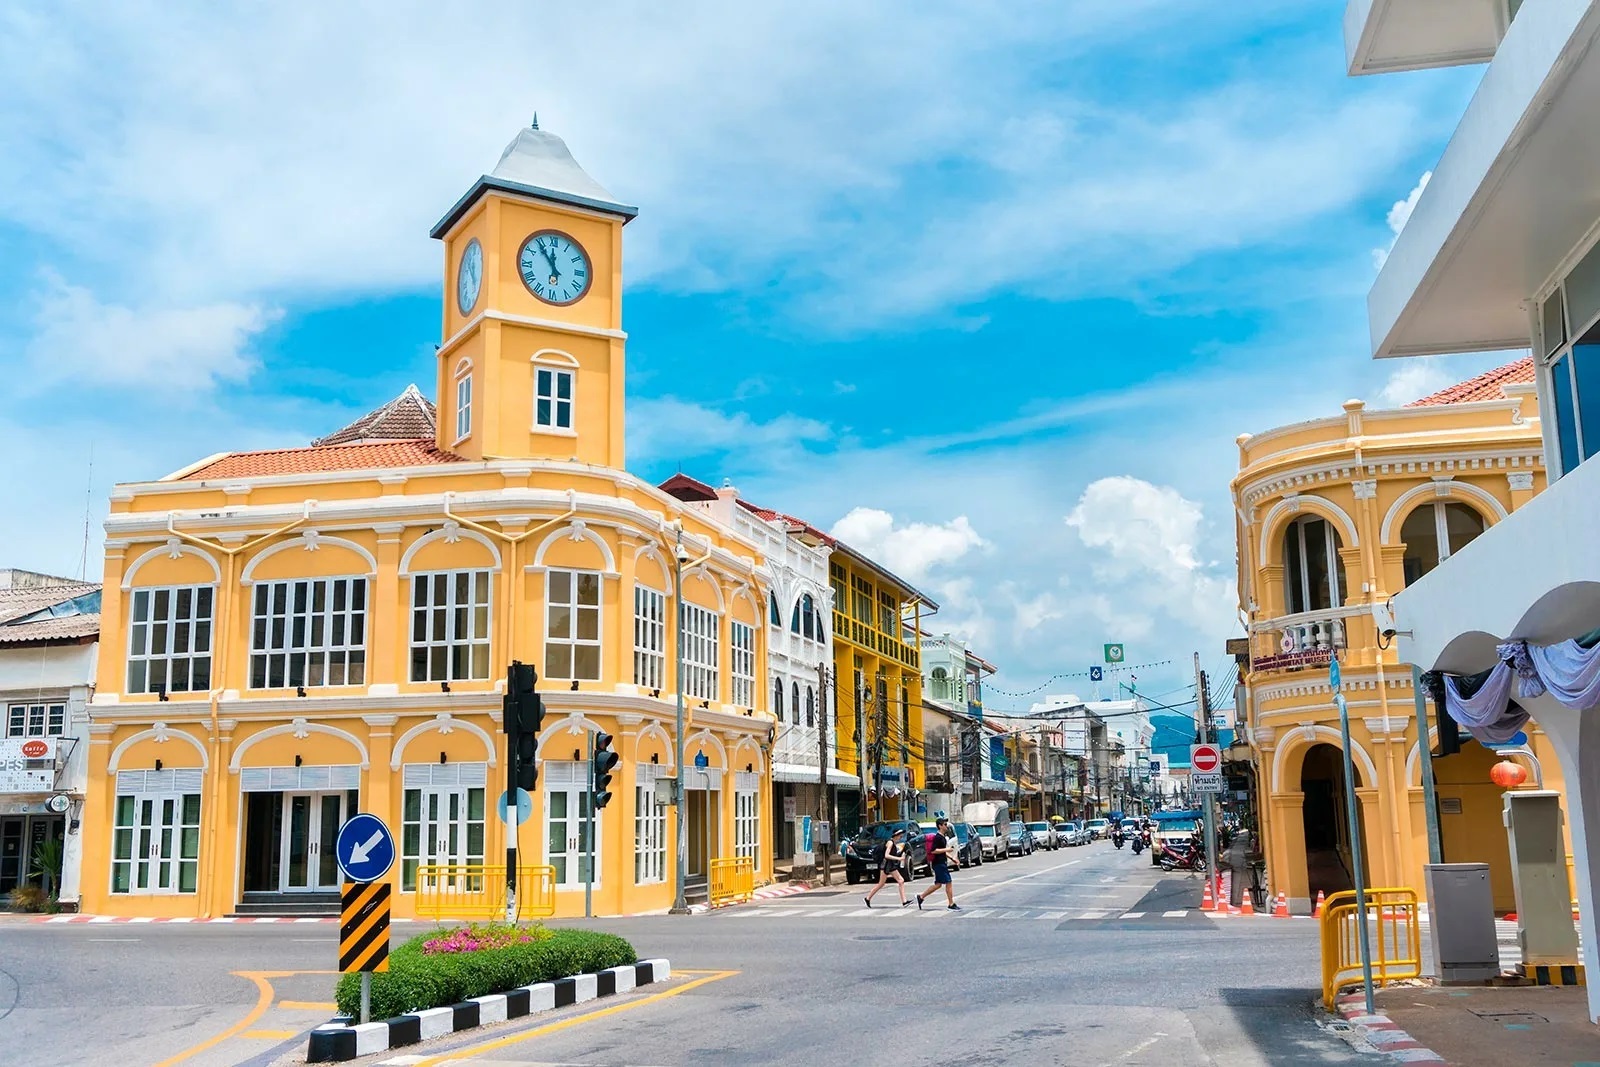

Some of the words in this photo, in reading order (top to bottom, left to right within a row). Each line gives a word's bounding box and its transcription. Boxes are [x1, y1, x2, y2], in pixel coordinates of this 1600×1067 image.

[525, 246, 537, 256] X
[564, 244, 570, 252] I
[522, 259, 533, 269] IX
[548, 289, 557, 301] VI
[563, 290, 571, 300] V
[1194, 776, 1220, 784] ห้ามเข้า
